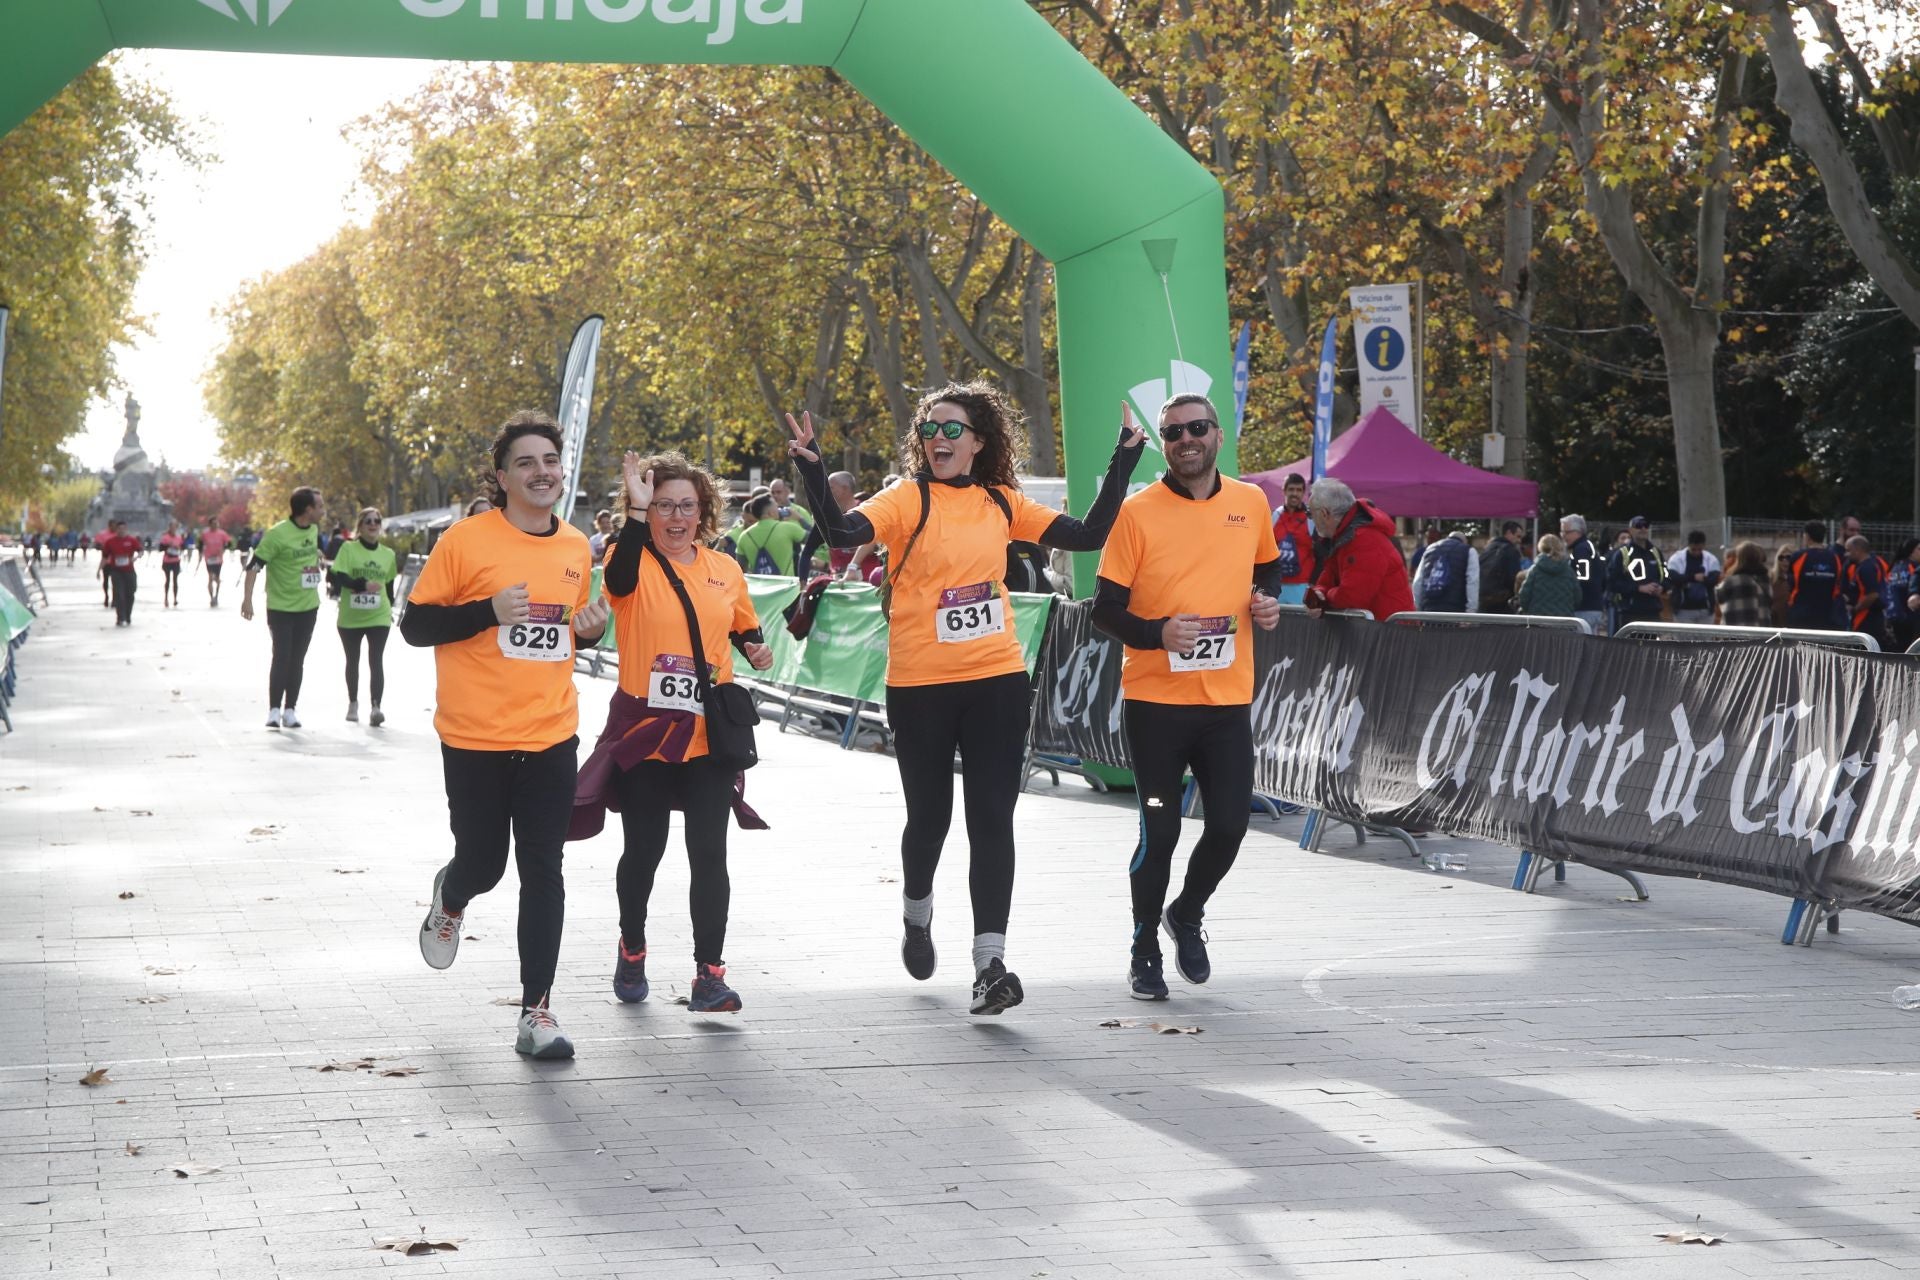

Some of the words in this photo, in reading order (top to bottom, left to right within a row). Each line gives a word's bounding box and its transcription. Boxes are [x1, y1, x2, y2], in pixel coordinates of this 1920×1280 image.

[1357, 294, 1383, 303] Oficina
[1384, 293, 1393, 302] de
[1227, 513, 1246, 523] luce
[565, 567, 580, 581] luce
[707, 577, 725, 587] luce
[354, 594, 376, 605] 434
[946, 603, 992, 631] 631
[509, 624, 559, 650] 629
[1417, 671, 1496, 790] El
[1490, 668, 1644, 818] Norte
[1645, 702, 1725, 828] de
